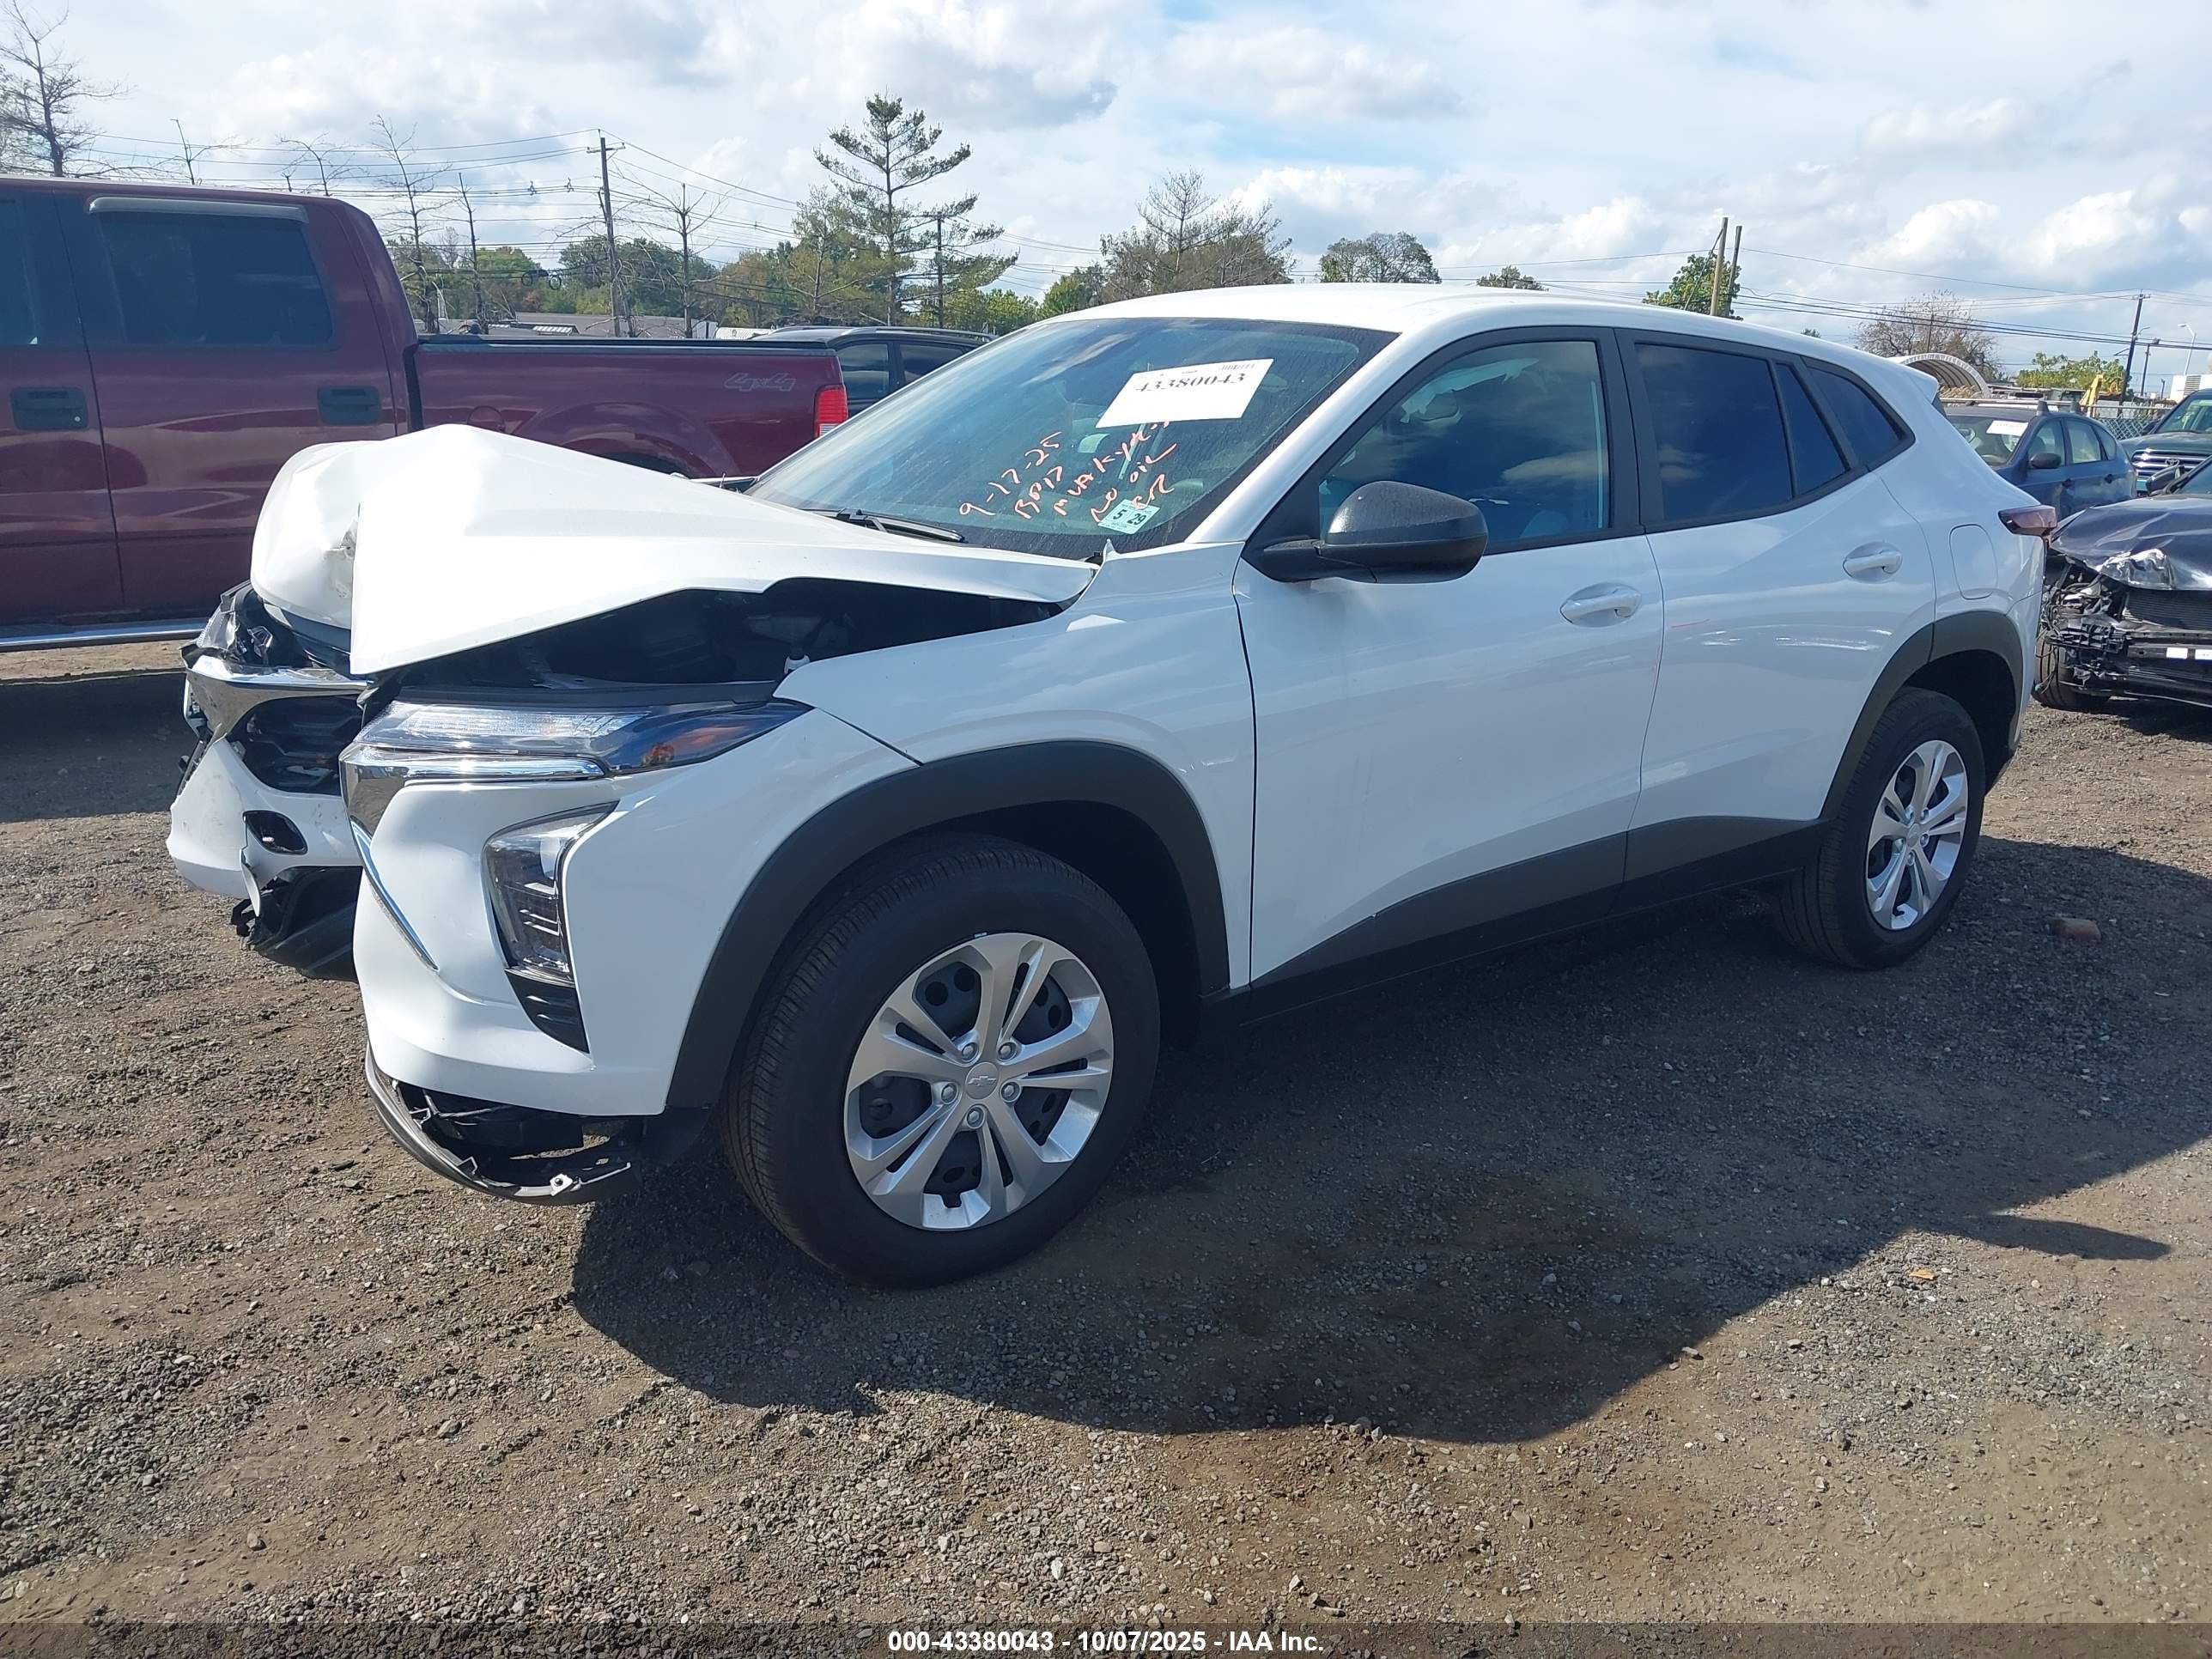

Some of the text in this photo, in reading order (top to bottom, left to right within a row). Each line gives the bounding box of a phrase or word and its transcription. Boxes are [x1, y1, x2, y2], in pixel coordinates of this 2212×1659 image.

[1134, 372, 1247, 393] 43380043
[959, 430, 1063, 516] 9-17-25
[1112, 508, 1127, 520] 5
[1126, 513, 1147, 526] 29
